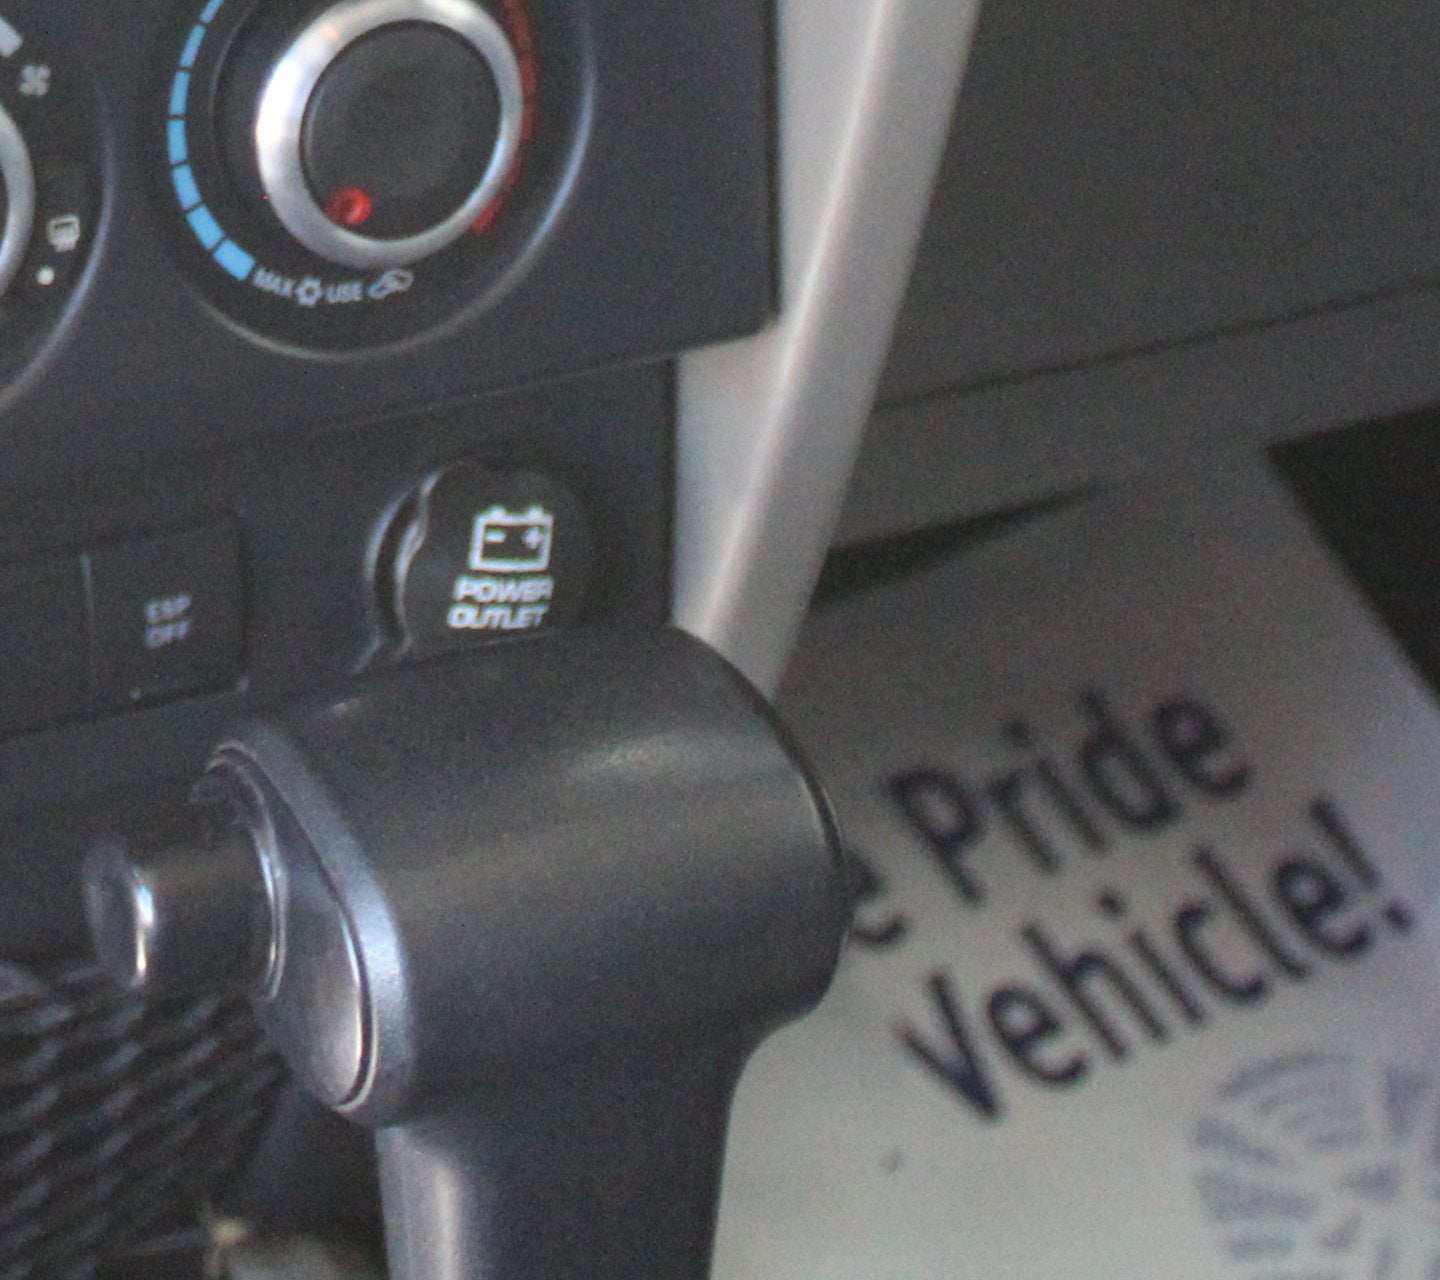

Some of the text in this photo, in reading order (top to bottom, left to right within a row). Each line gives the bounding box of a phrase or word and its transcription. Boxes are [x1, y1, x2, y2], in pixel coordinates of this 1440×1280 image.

[447, 602, 548, 630] OUTLET
[453, 575, 554, 602] POWER
[882, 684, 1254, 904] Pride
[895, 793, 1414, 1122] Vehicle!
